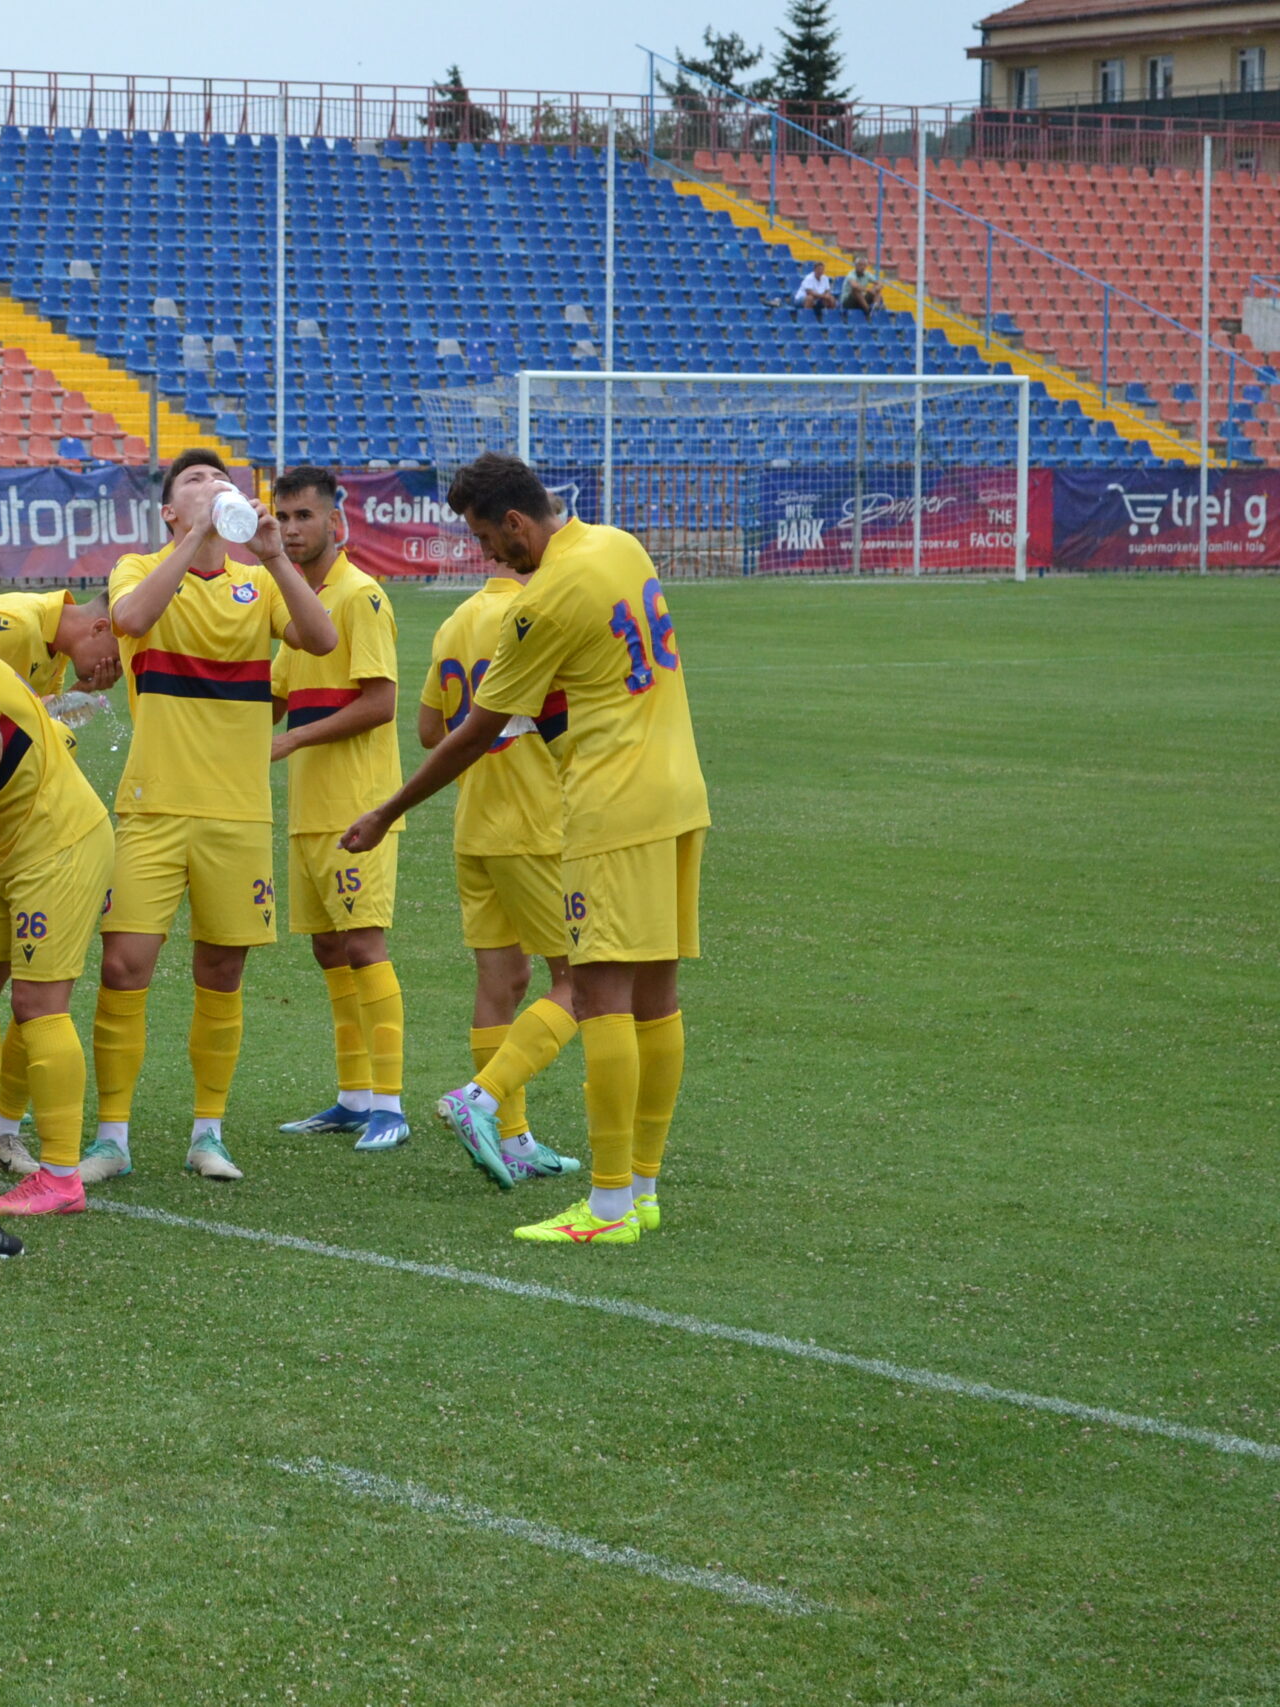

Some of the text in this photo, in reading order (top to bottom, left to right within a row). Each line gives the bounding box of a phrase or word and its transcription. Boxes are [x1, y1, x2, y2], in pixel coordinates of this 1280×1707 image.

[363, 496, 467, 524] fcbiho
[987, 508, 1012, 525] THE
[1172, 488, 1268, 538] trei g
[777, 518, 825, 550] PARK
[1128, 542, 1200, 555] supermarketu
[608, 577, 679, 696] 16
[335, 867, 362, 895] 15
[564, 891, 587, 921] 16
[16, 911, 48, 939] 26
